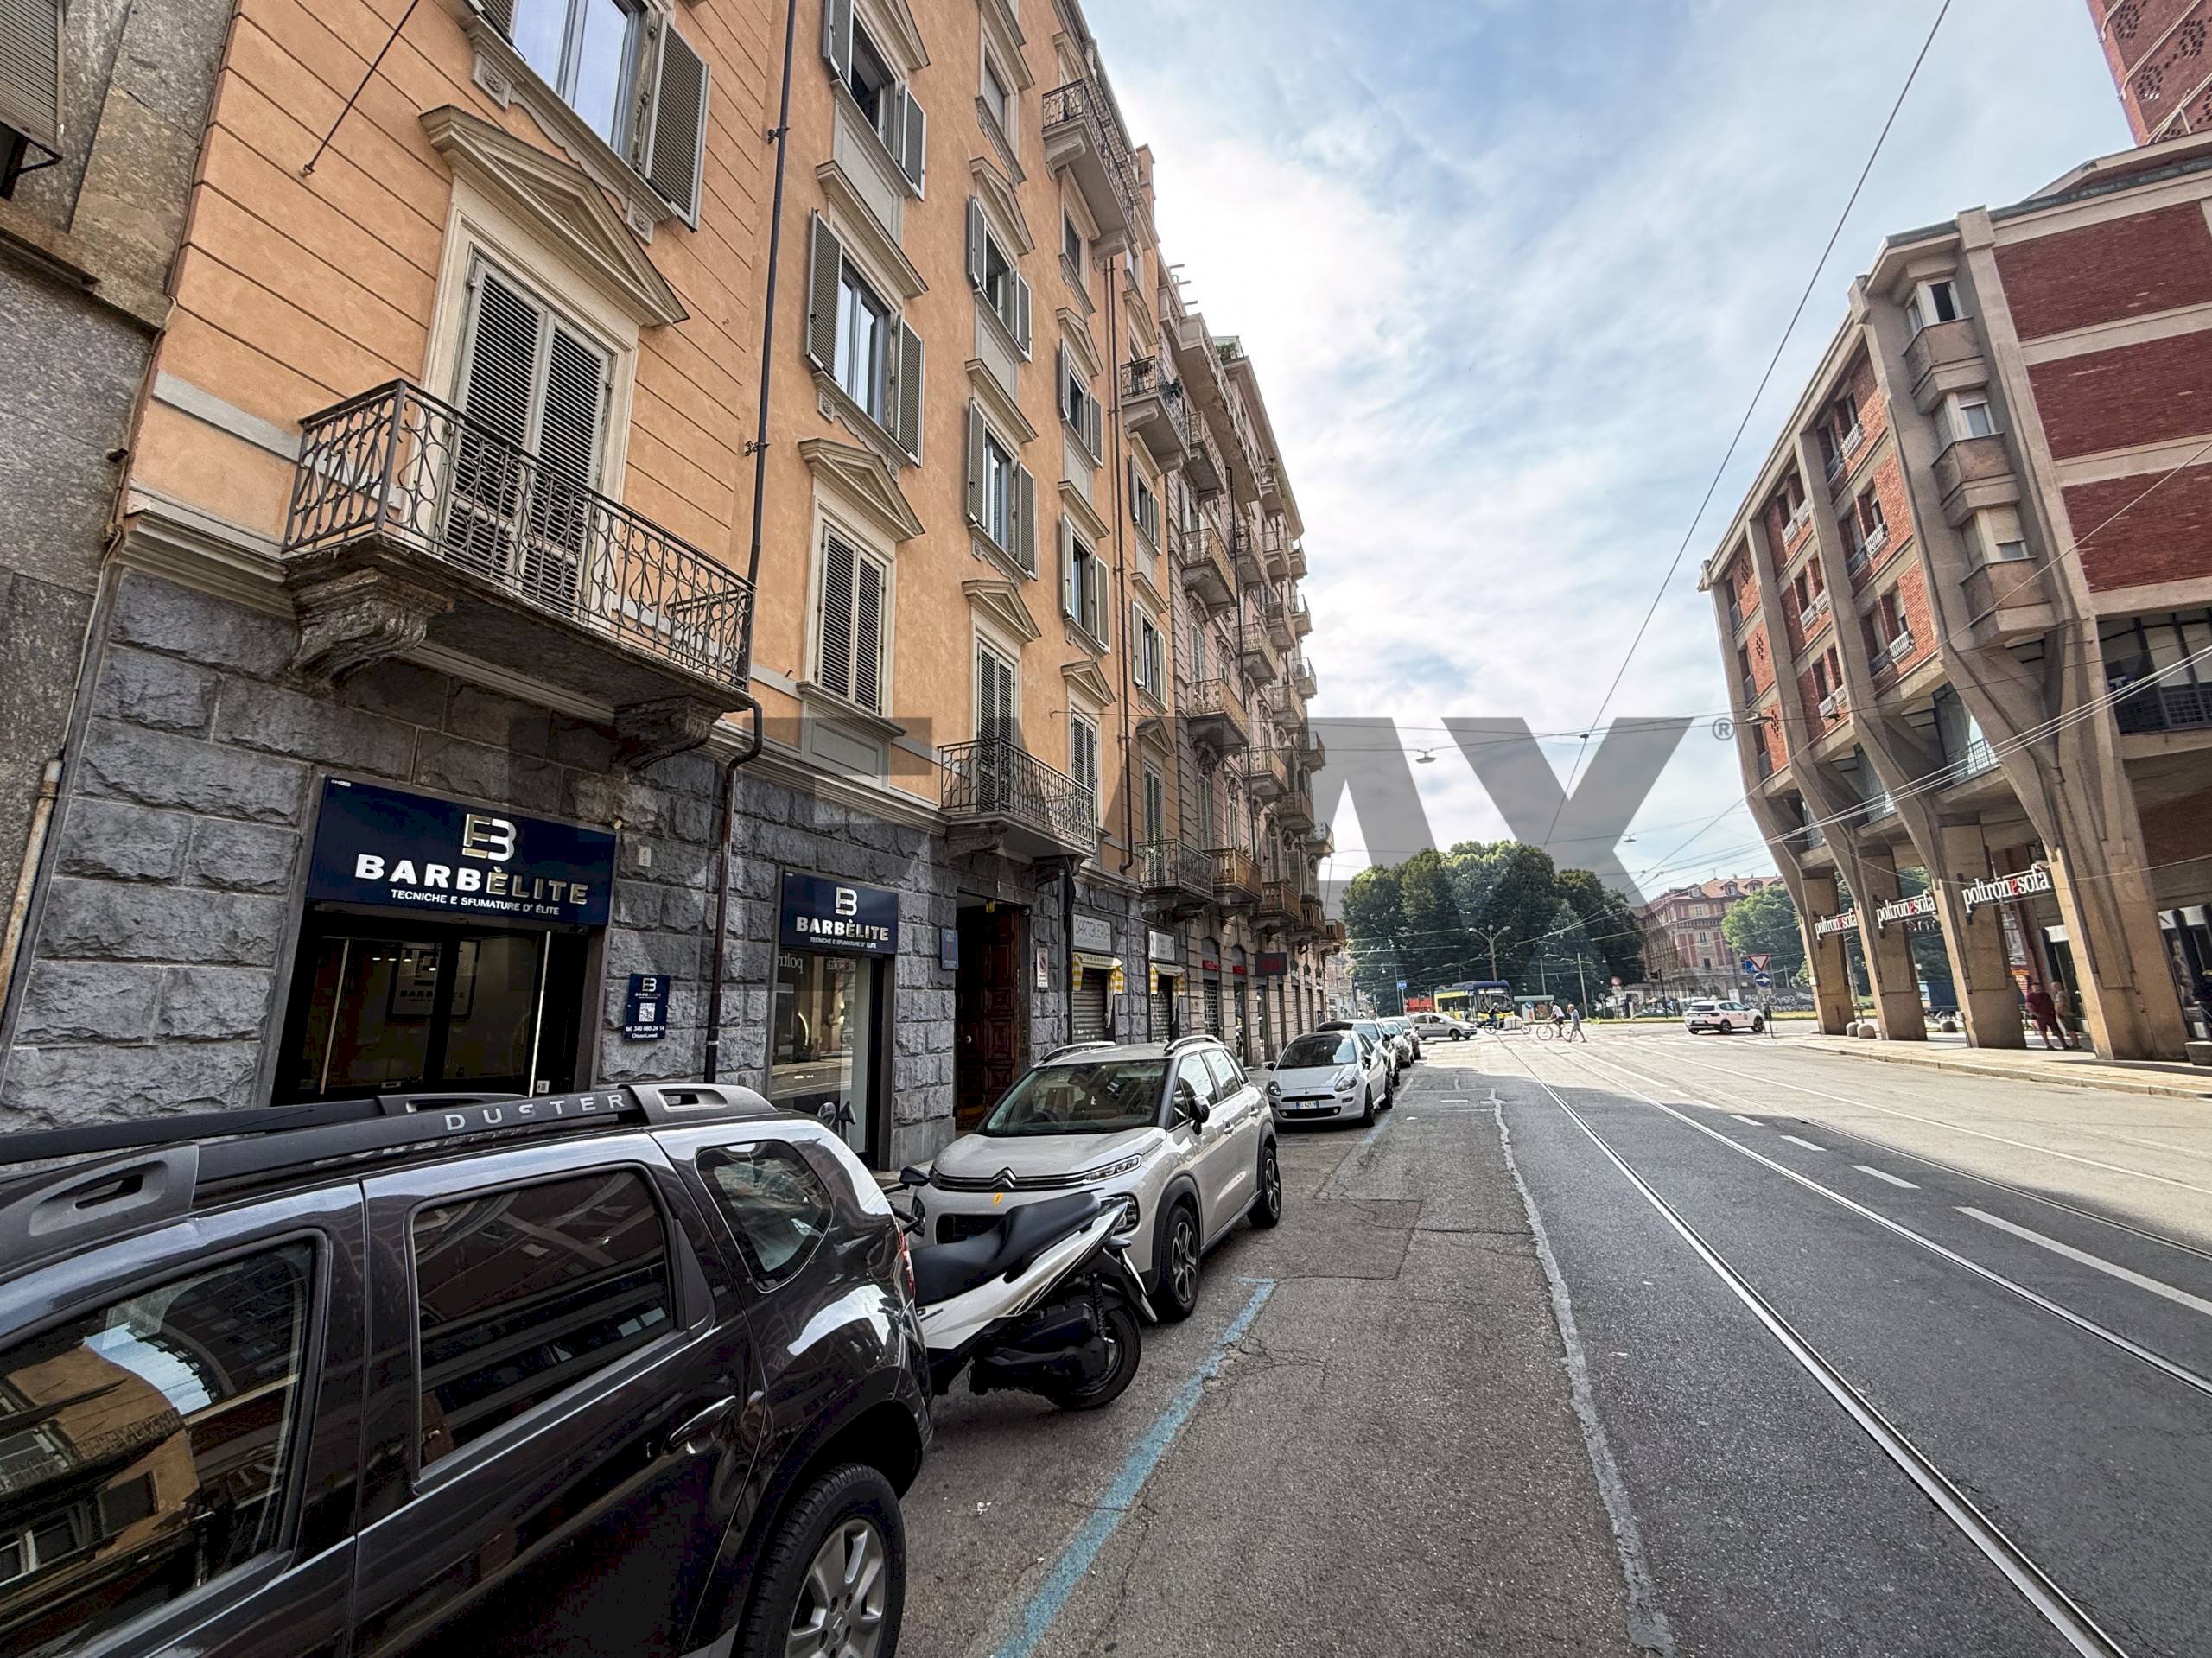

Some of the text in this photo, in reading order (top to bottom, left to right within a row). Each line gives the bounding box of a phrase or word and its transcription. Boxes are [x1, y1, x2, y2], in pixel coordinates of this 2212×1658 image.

[354, 854, 589, 905] BARBÈLITE
[1961, 863, 2052, 913] poltronesofà
[391, 888, 448, 905] TECNICHE
[450, 895, 458, 905] E
[461, 897, 520, 912] SFUMATURE
[536, 905, 560, 916] ÉLITE
[1875, 889, 1937, 930] poltronesofà
[796, 916, 890, 942] BARBÈLITE
[445, 1094, 626, 1132] DUSTER
